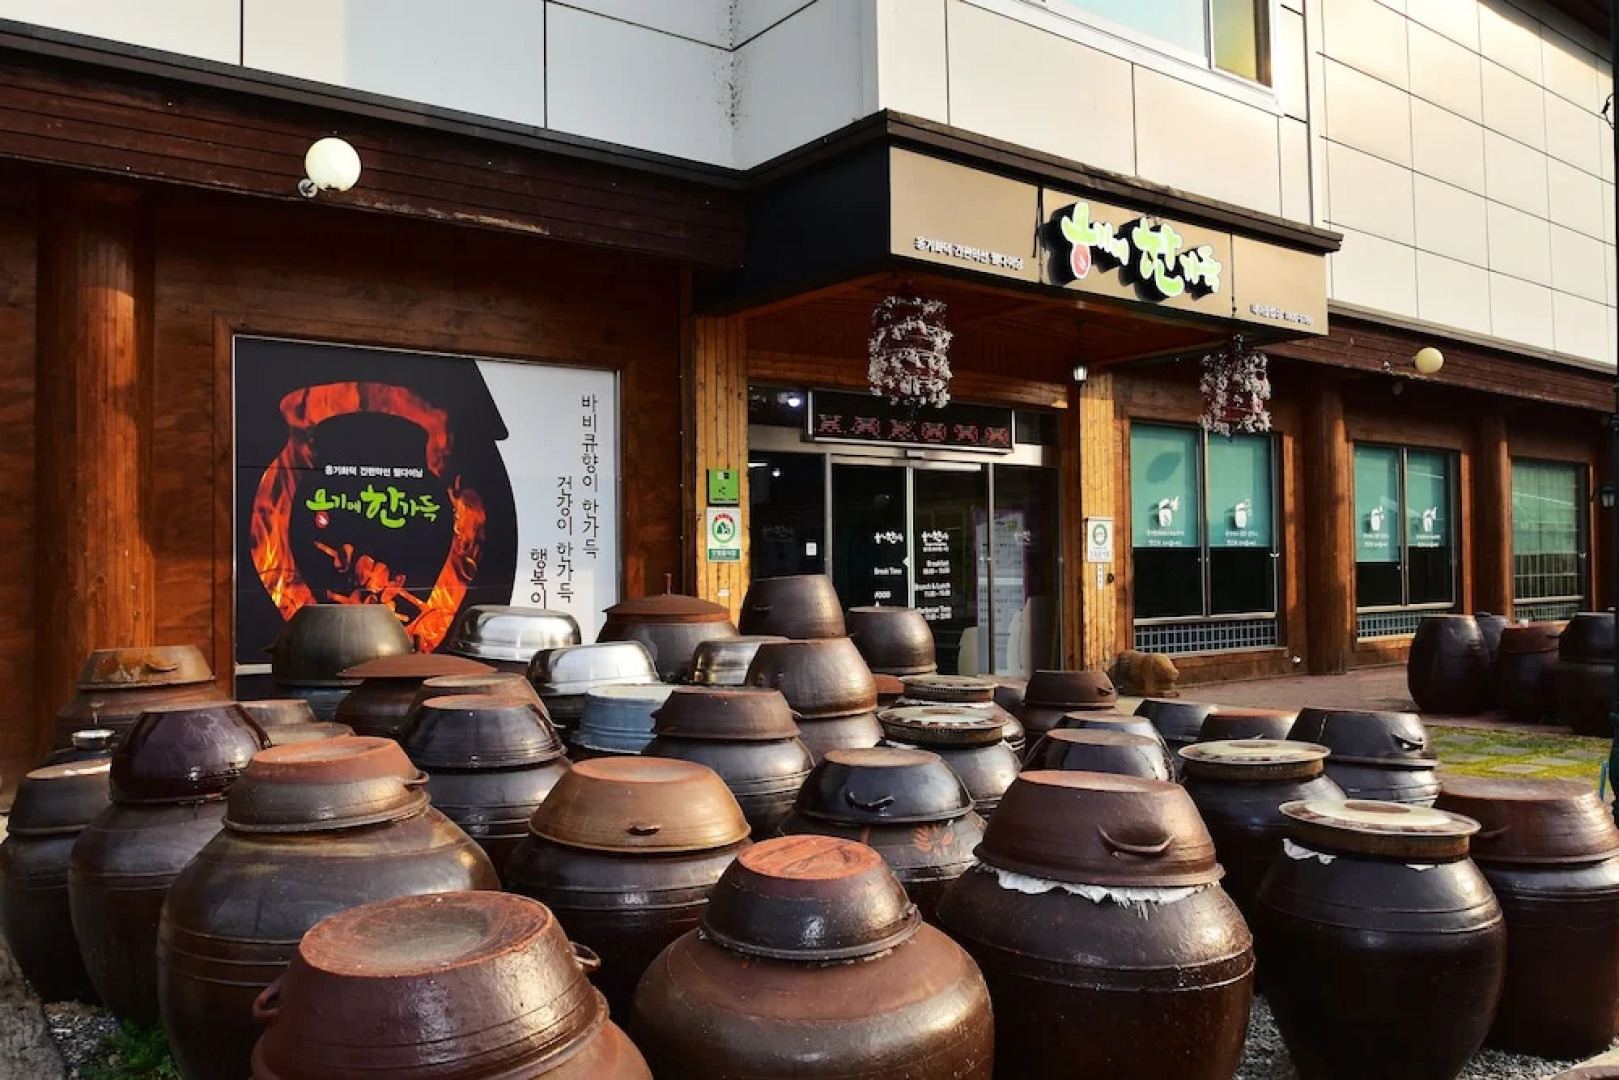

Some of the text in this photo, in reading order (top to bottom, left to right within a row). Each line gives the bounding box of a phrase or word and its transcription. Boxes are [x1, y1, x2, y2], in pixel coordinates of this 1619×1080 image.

[1132, 216, 1222, 297] 한가득
[360, 484, 440, 528] 한가득
[580, 393, 600, 559] 바비큐향이 한가득
[531, 548, 548, 609] 행복이
[556, 475, 574, 603] 건강이 한가득
